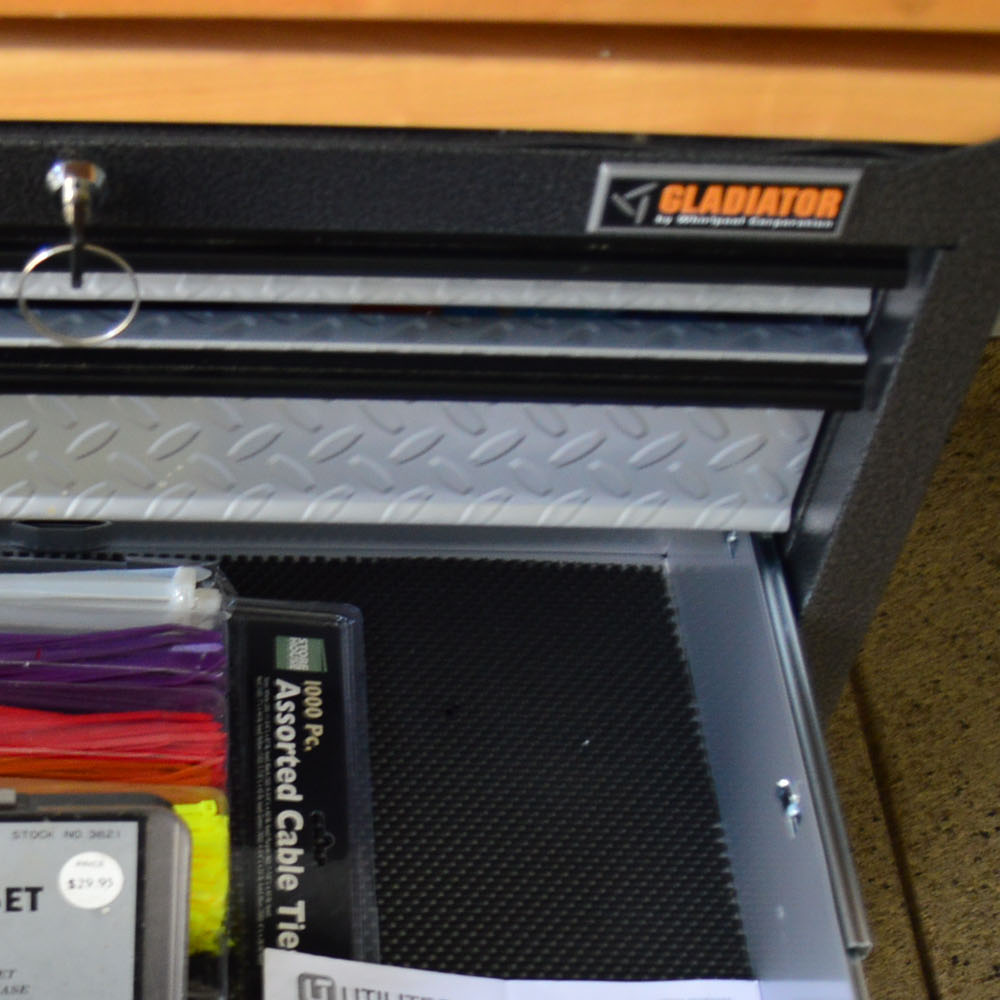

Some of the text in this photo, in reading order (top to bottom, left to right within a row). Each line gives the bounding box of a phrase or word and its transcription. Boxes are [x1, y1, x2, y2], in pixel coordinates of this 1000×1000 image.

[658, 183, 844, 218] GLADIATOR
[304, 680, 324, 751] 1000 Pc.
[276, 678, 306, 950] Assorted Cable Tie
